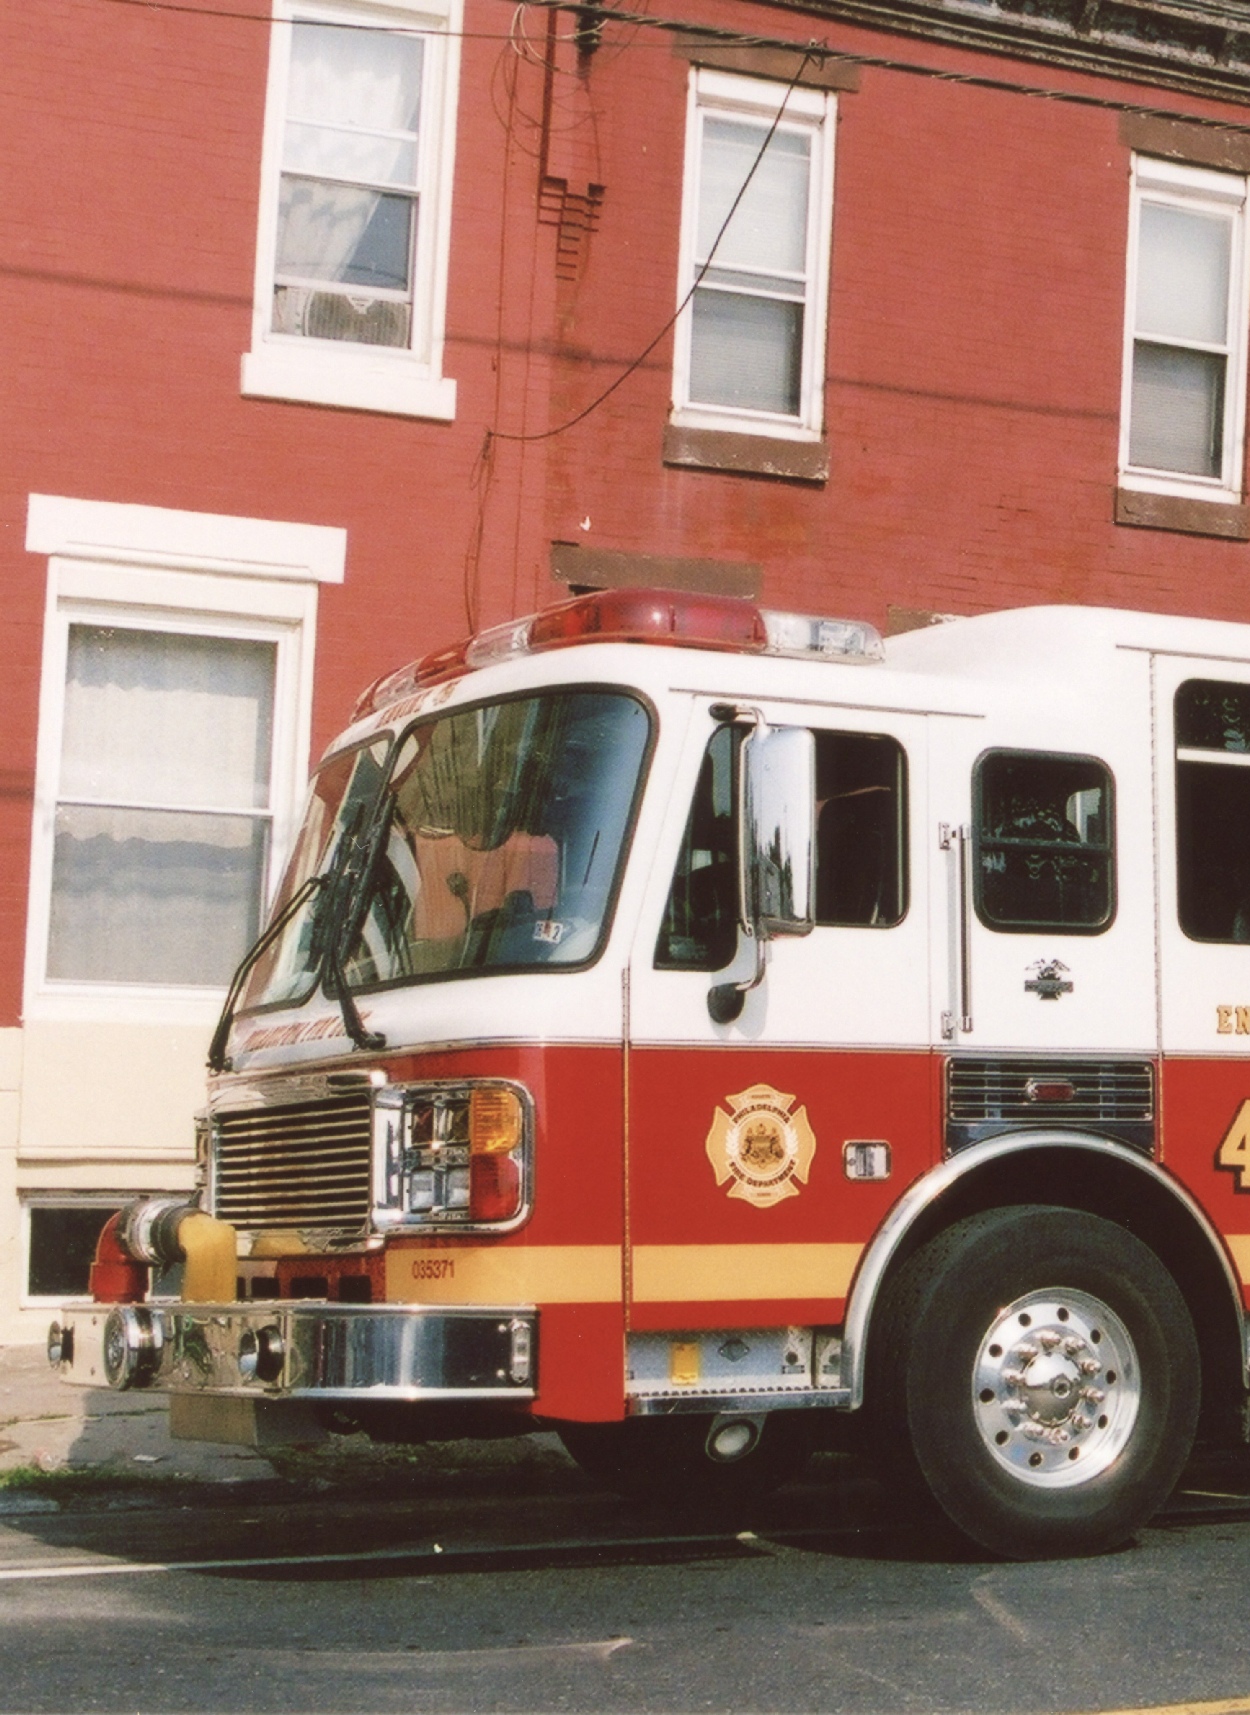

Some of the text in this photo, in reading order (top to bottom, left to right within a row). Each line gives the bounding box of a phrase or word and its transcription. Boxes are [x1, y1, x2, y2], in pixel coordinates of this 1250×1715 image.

[732, 1103, 791, 1124] PHILADELPHIA
[729, 1159, 796, 1188] FIRE DEPARTMENT
[411, 1259, 455, 1280] 035371
